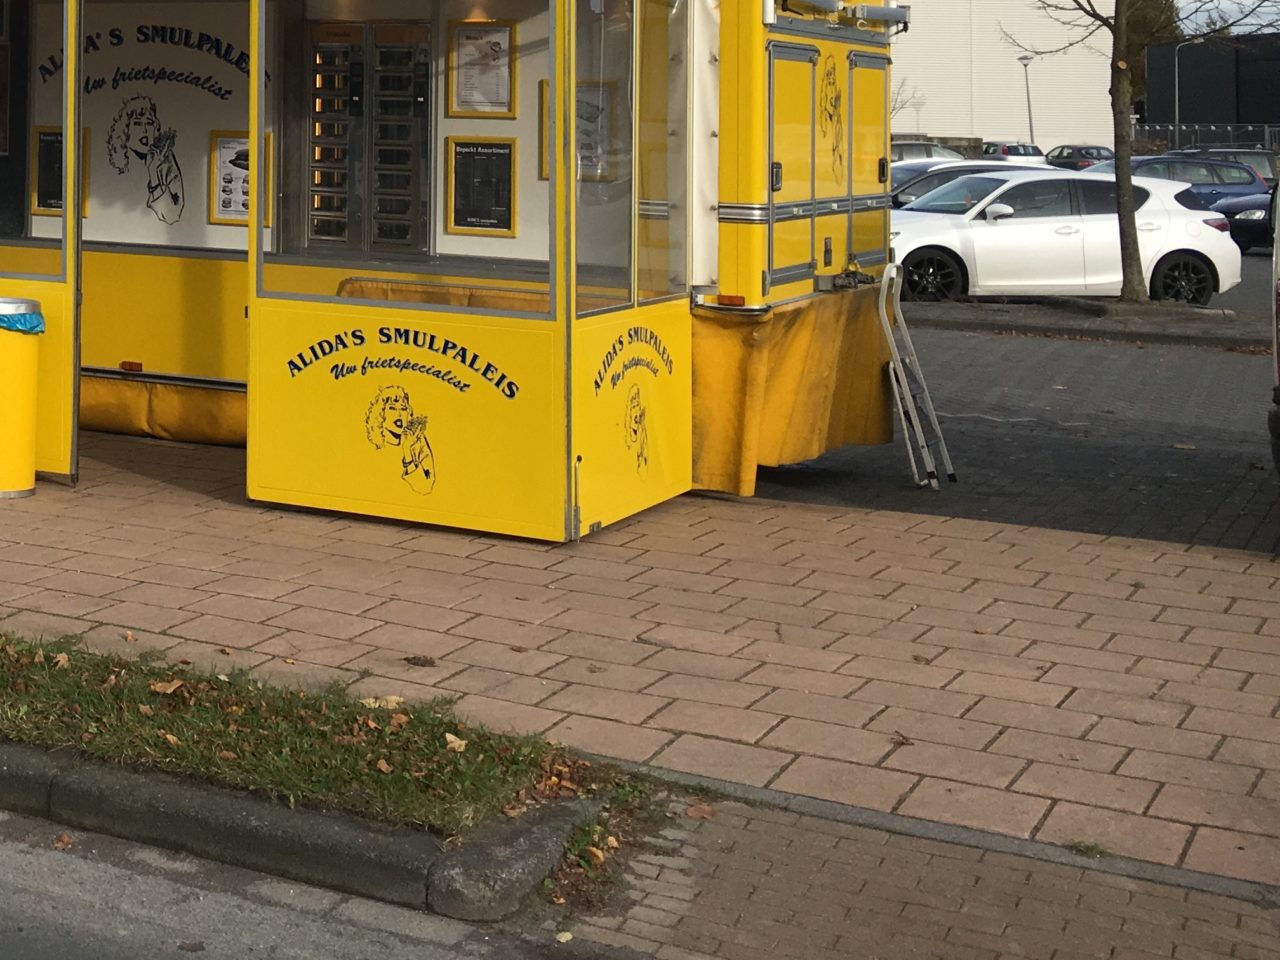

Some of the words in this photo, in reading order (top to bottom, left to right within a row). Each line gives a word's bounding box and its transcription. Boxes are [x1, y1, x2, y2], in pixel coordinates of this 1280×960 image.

[38, 28, 124, 83] ALA'S
[136, 25, 271, 88] SMULPALE
[112, 66, 232, 101] frietspecialist
[286, 328, 367, 378] ALIDA'S
[378, 326, 520, 400] SMULPALEIS
[330, 361, 358, 381] Uw
[360, 356, 471, 393] frietspecialist
[594, 334, 624, 397] ALIDA'S
[627, 326, 674, 376] SMULPALEIS
